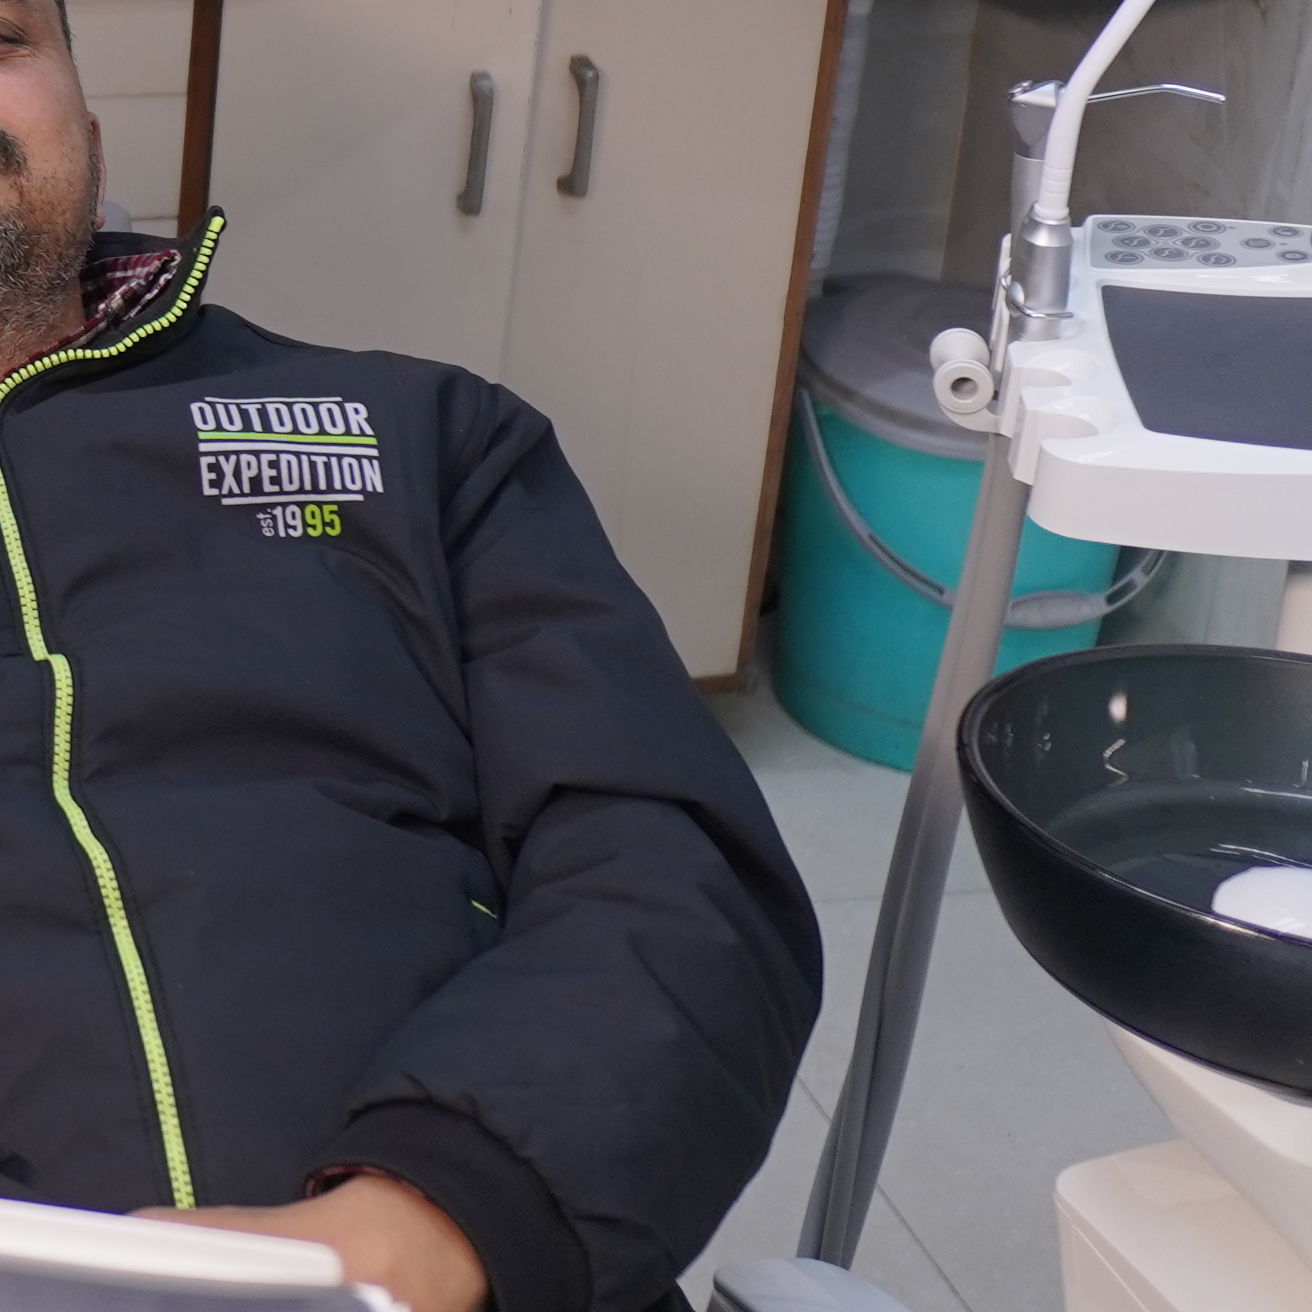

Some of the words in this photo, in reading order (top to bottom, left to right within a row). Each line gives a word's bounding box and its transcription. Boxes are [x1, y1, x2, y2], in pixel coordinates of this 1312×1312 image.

[189, 401, 375, 436] OUTDOOR
[199, 453, 384, 496] EXPEDITION
[272, 504, 342, 538] 1995
